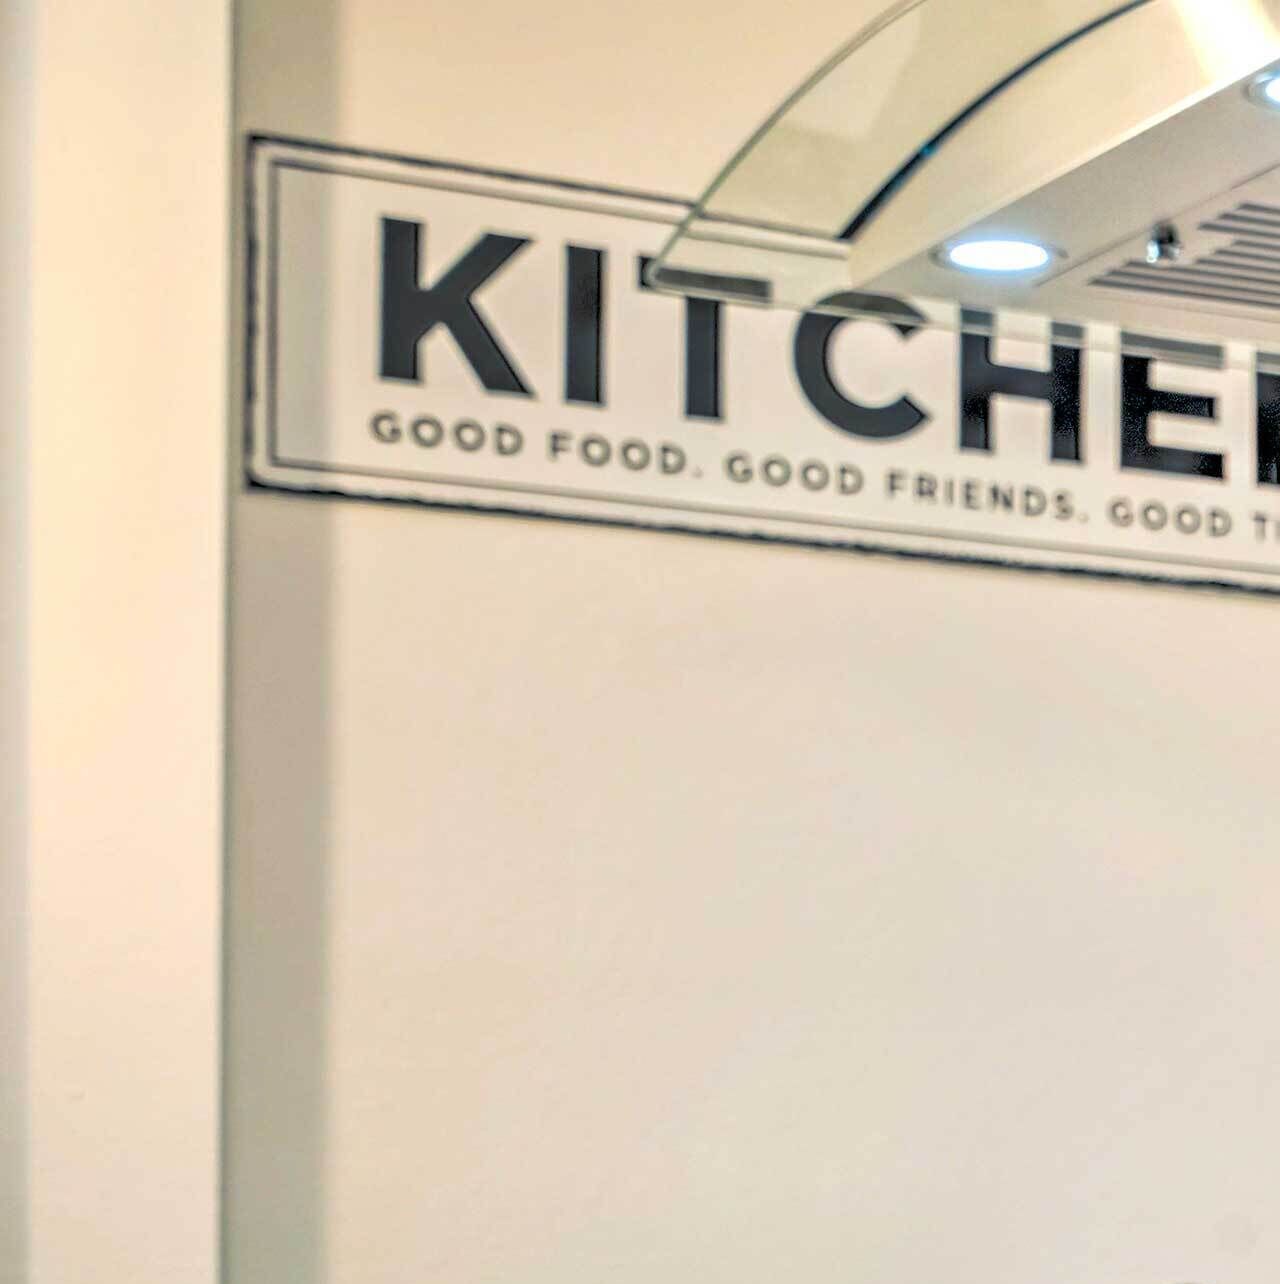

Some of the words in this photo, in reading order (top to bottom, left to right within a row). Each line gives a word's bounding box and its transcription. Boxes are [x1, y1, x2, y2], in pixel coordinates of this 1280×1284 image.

[371, 411, 523, 455] GOOD
[551, 432, 703, 477] FOOD.
[725, 451, 864, 495] GOOD
[887, 470, 1088, 522] FRIENDS.
[1107, 499, 1233, 536] GOOD
